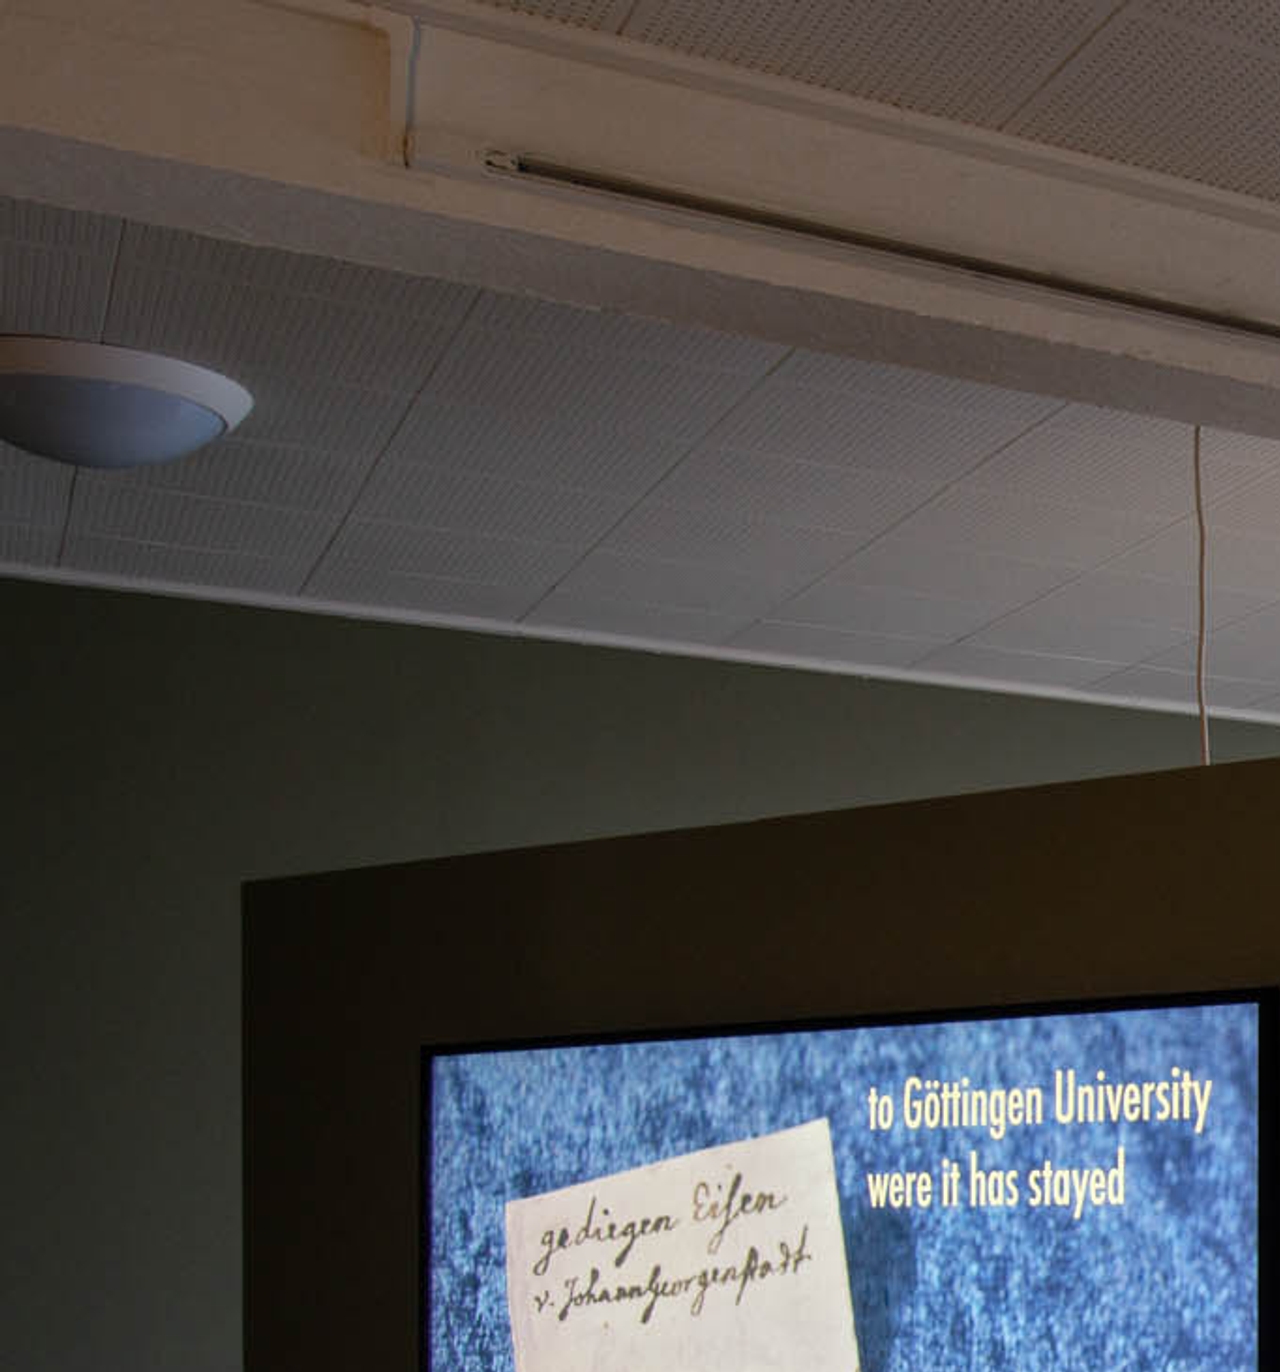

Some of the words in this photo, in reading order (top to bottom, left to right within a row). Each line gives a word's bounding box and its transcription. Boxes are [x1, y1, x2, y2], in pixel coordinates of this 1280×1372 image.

[868, 1087, 894, 1131] to
[904, 1076, 1044, 1140] Göttingen
[1055, 1066, 1213, 1134] University
[867, 1170, 932, 1208] were
[942, 1158, 961, 1207] it
[970, 1150, 1019, 1207] has
[1028, 1146, 1126, 1220] stayed
